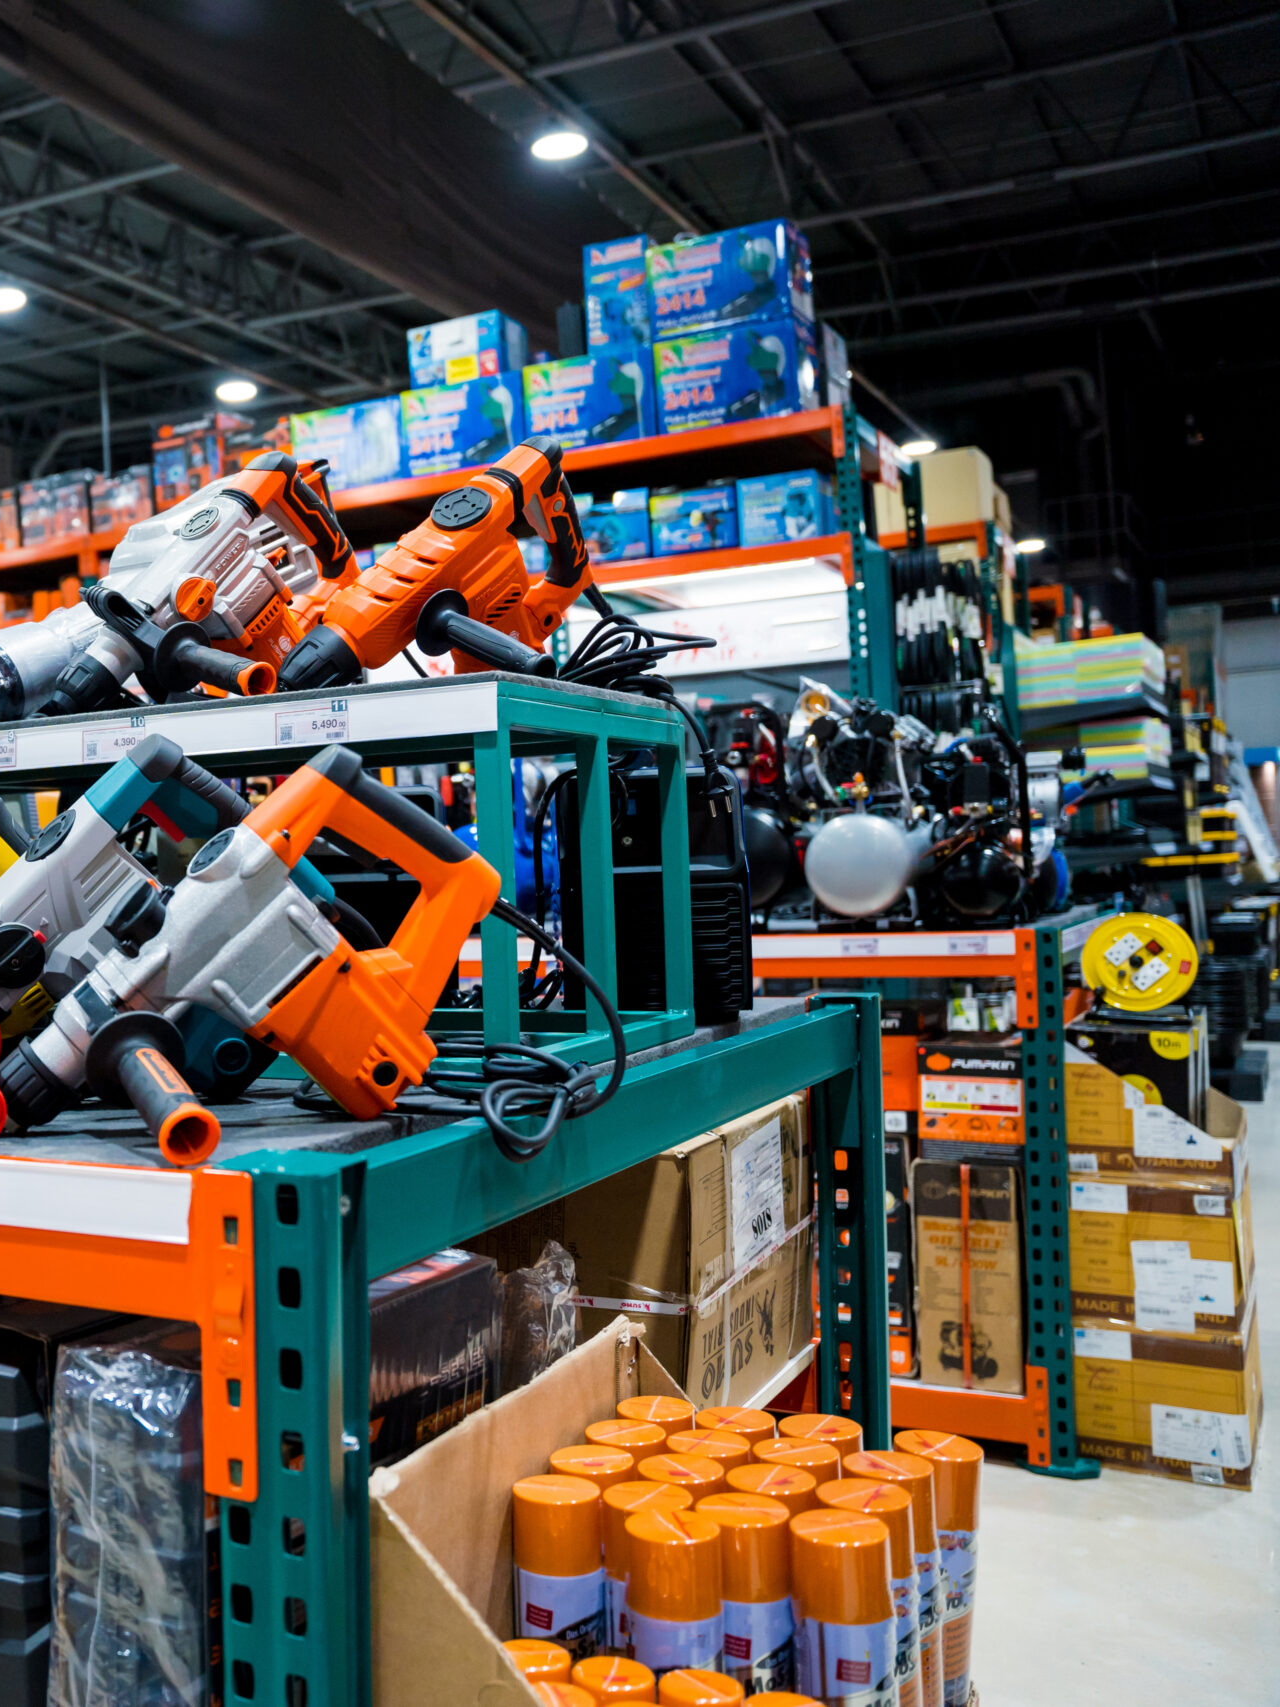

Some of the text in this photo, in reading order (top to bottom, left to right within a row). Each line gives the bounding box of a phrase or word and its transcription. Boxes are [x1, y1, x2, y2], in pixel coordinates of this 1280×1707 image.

[332, 700, 347, 712] 11
[131, 717, 145, 727] 10
[951, 1057, 1015, 1071] PUMPKIN
[1075, 1298, 1119, 1314] MADE
[703, 1295, 754, 1358] INDUSRIAL
